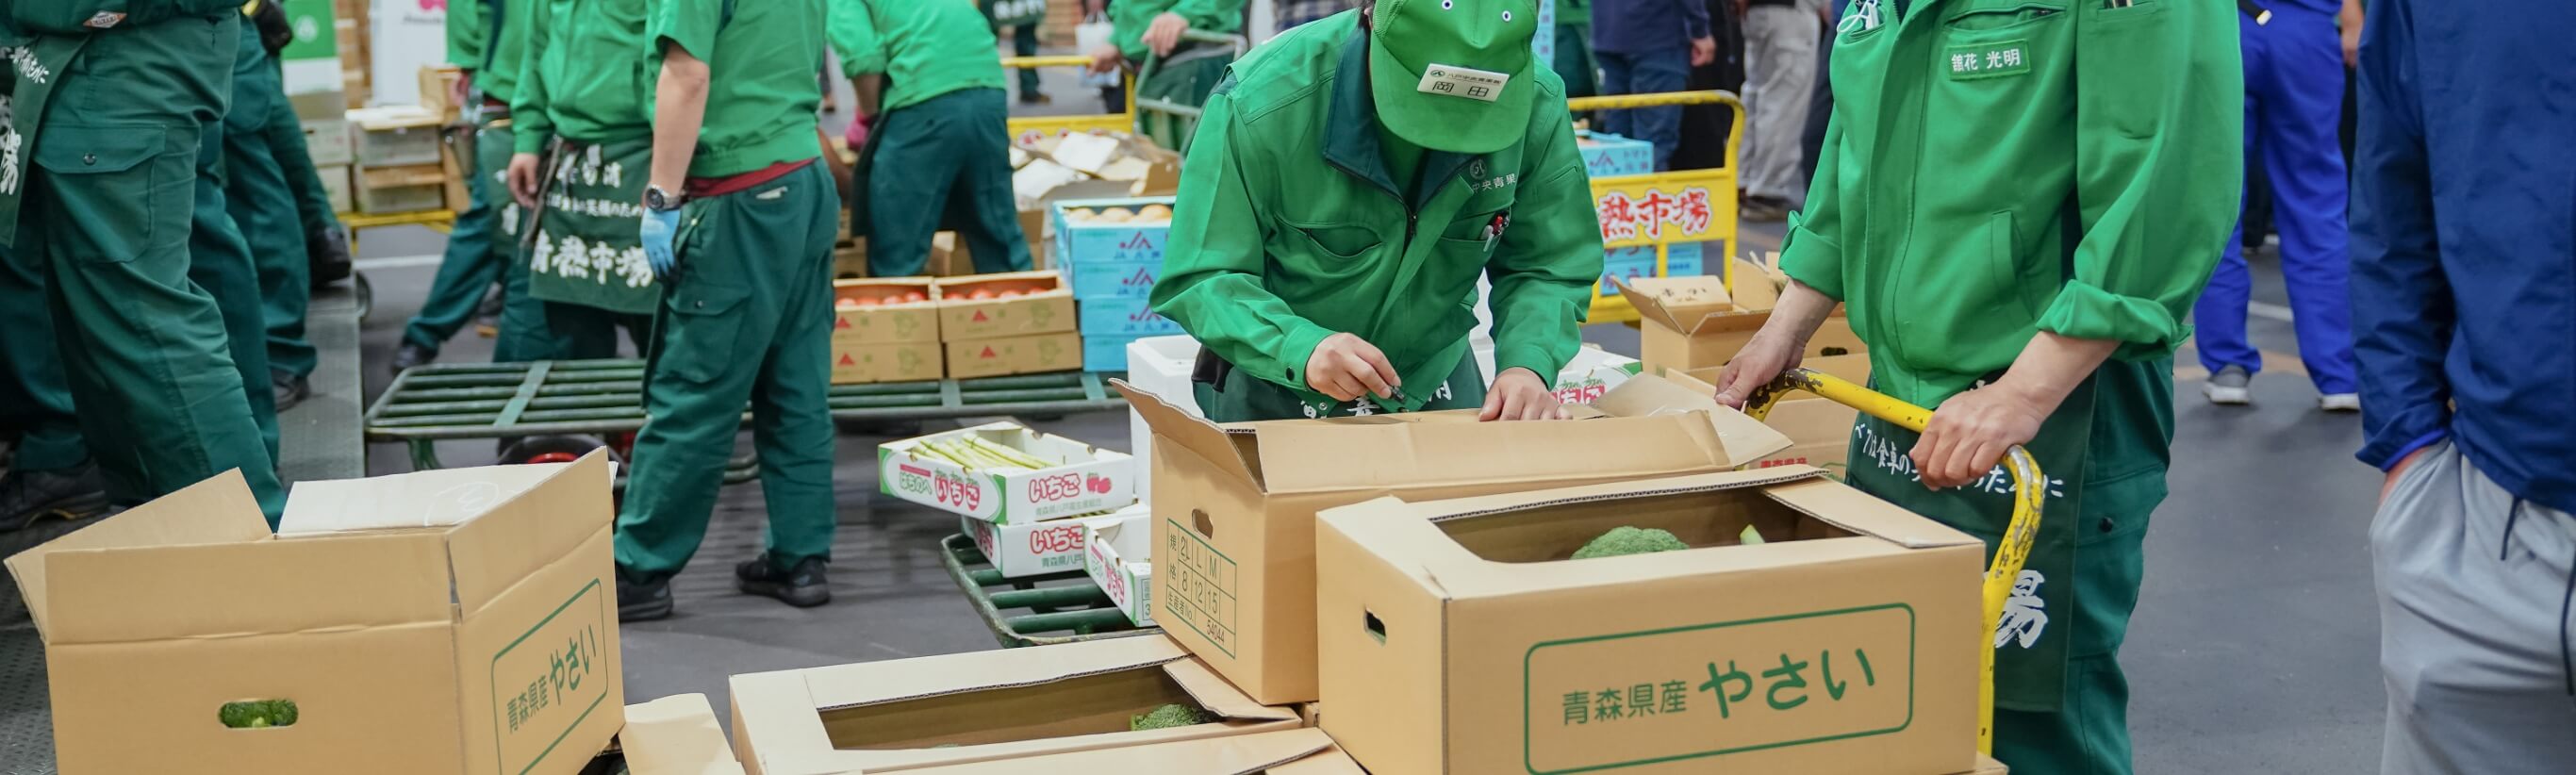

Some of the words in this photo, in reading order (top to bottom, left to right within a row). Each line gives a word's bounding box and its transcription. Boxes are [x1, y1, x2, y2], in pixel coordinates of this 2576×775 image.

[1985, 48, 2022, 69] 光明
[1432, 80, 1490, 98] 岡田
[935, 475, 981, 511] いちご
[1029, 472, 1082, 503] いちご
[1197, 546, 1202, 569] L
[1210, 554, 1217, 579] M
[1181, 570, 1188, 592] 8
[1195, 581, 1203, 604] 12
[1208, 590, 1218, 614] 15
[1206, 618, 1225, 644] 54044
[506, 674, 549, 734] 青森県産
[549, 623, 597, 705] やさい
[1562, 680, 1688, 726] 青森県産
[1698, 648, 1875, 719] やさい
